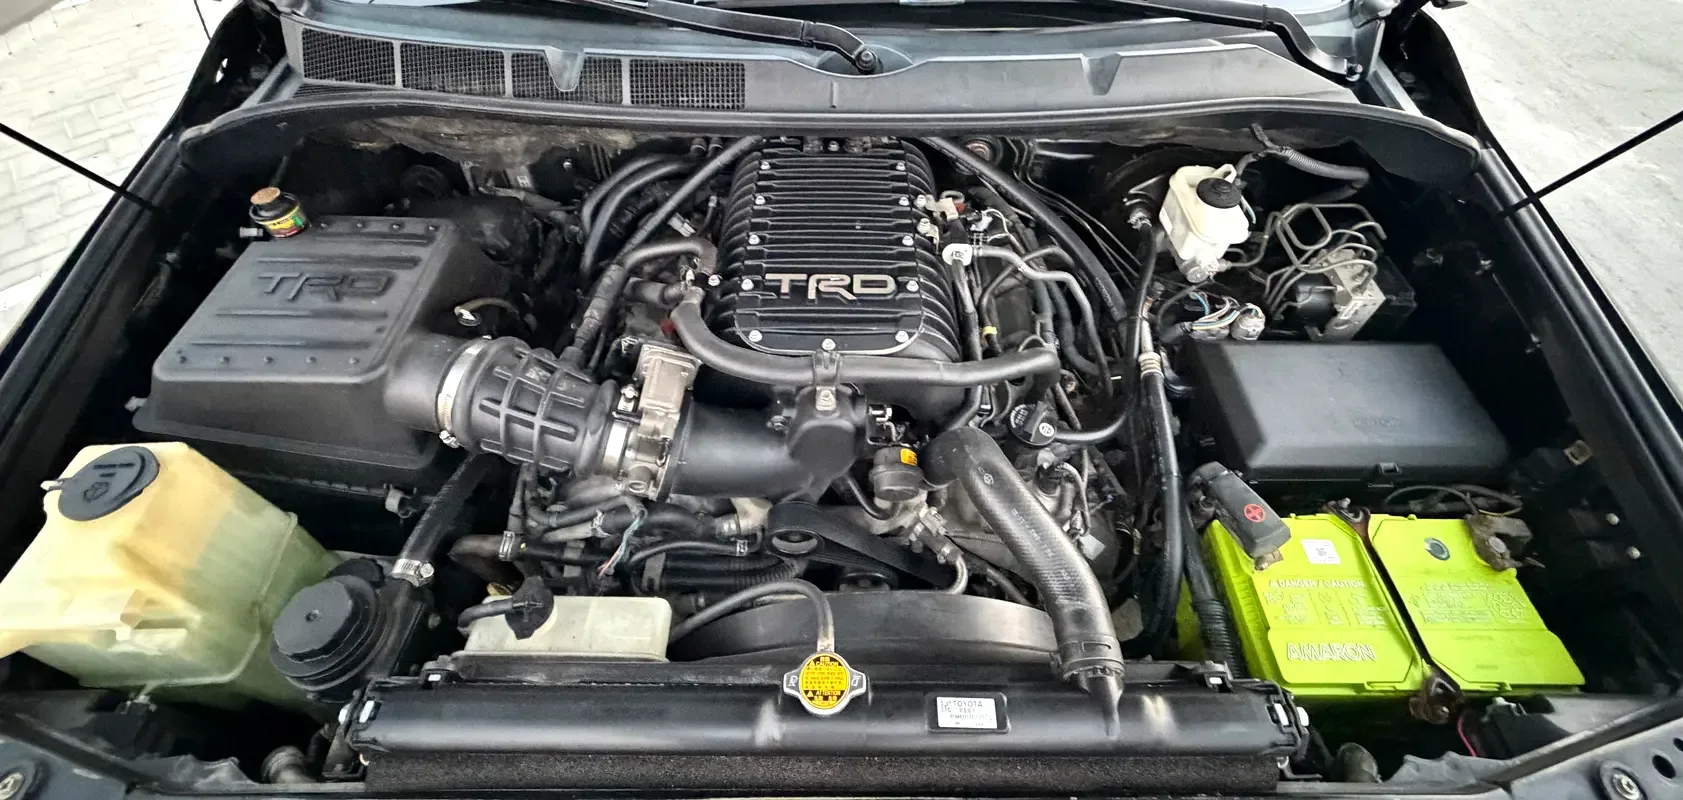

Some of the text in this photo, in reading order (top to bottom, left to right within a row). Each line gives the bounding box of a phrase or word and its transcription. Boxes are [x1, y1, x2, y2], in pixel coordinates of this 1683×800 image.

[257, 271, 396, 301] TRD
[765, 273, 896, 300] TRD
[1280, 579, 1316, 588] DANGER
[1323, 579, 1365, 588] CAUTION
[1287, 643, 1377, 662] AMARON
[953, 700, 983, 708] TOYOTA
